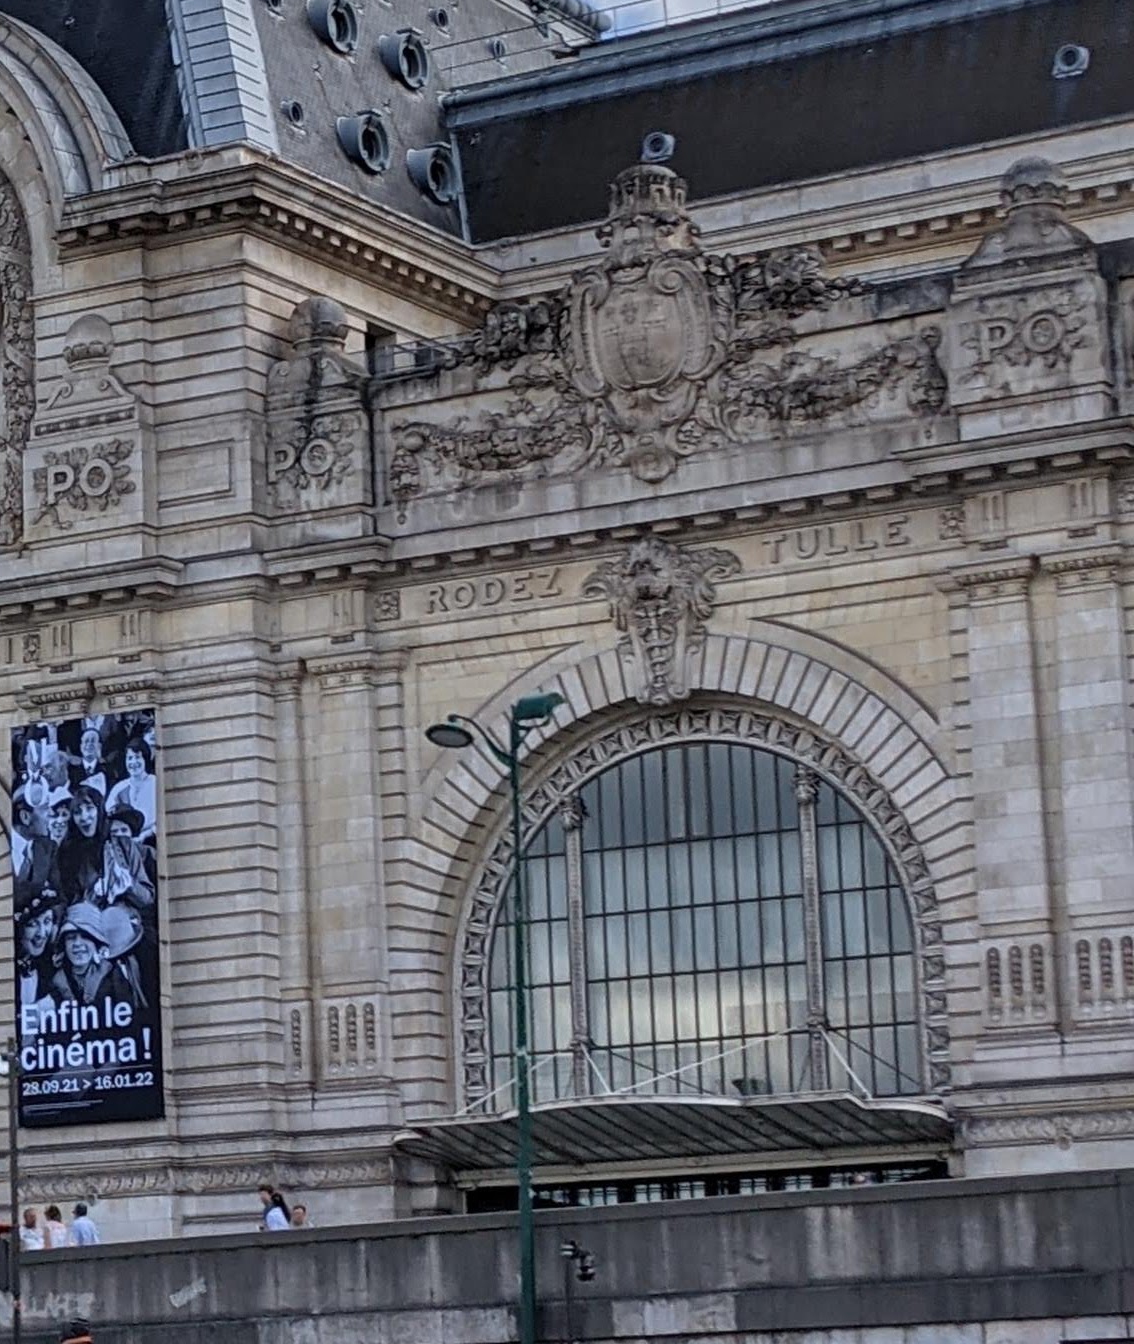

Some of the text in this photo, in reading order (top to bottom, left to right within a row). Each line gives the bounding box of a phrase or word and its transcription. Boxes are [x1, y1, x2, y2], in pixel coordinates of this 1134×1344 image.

[980, 312, 1064, 363] PO
[47, 458, 111, 505] PO
[762, 514, 911, 565] TULLE
[425, 567, 563, 615] RODEZ
[21, 995, 132, 1035] Enfin le
[22, 1078, 80, 1096] 28.09.21
[94, 1071, 154, 1090] 16.01.22
